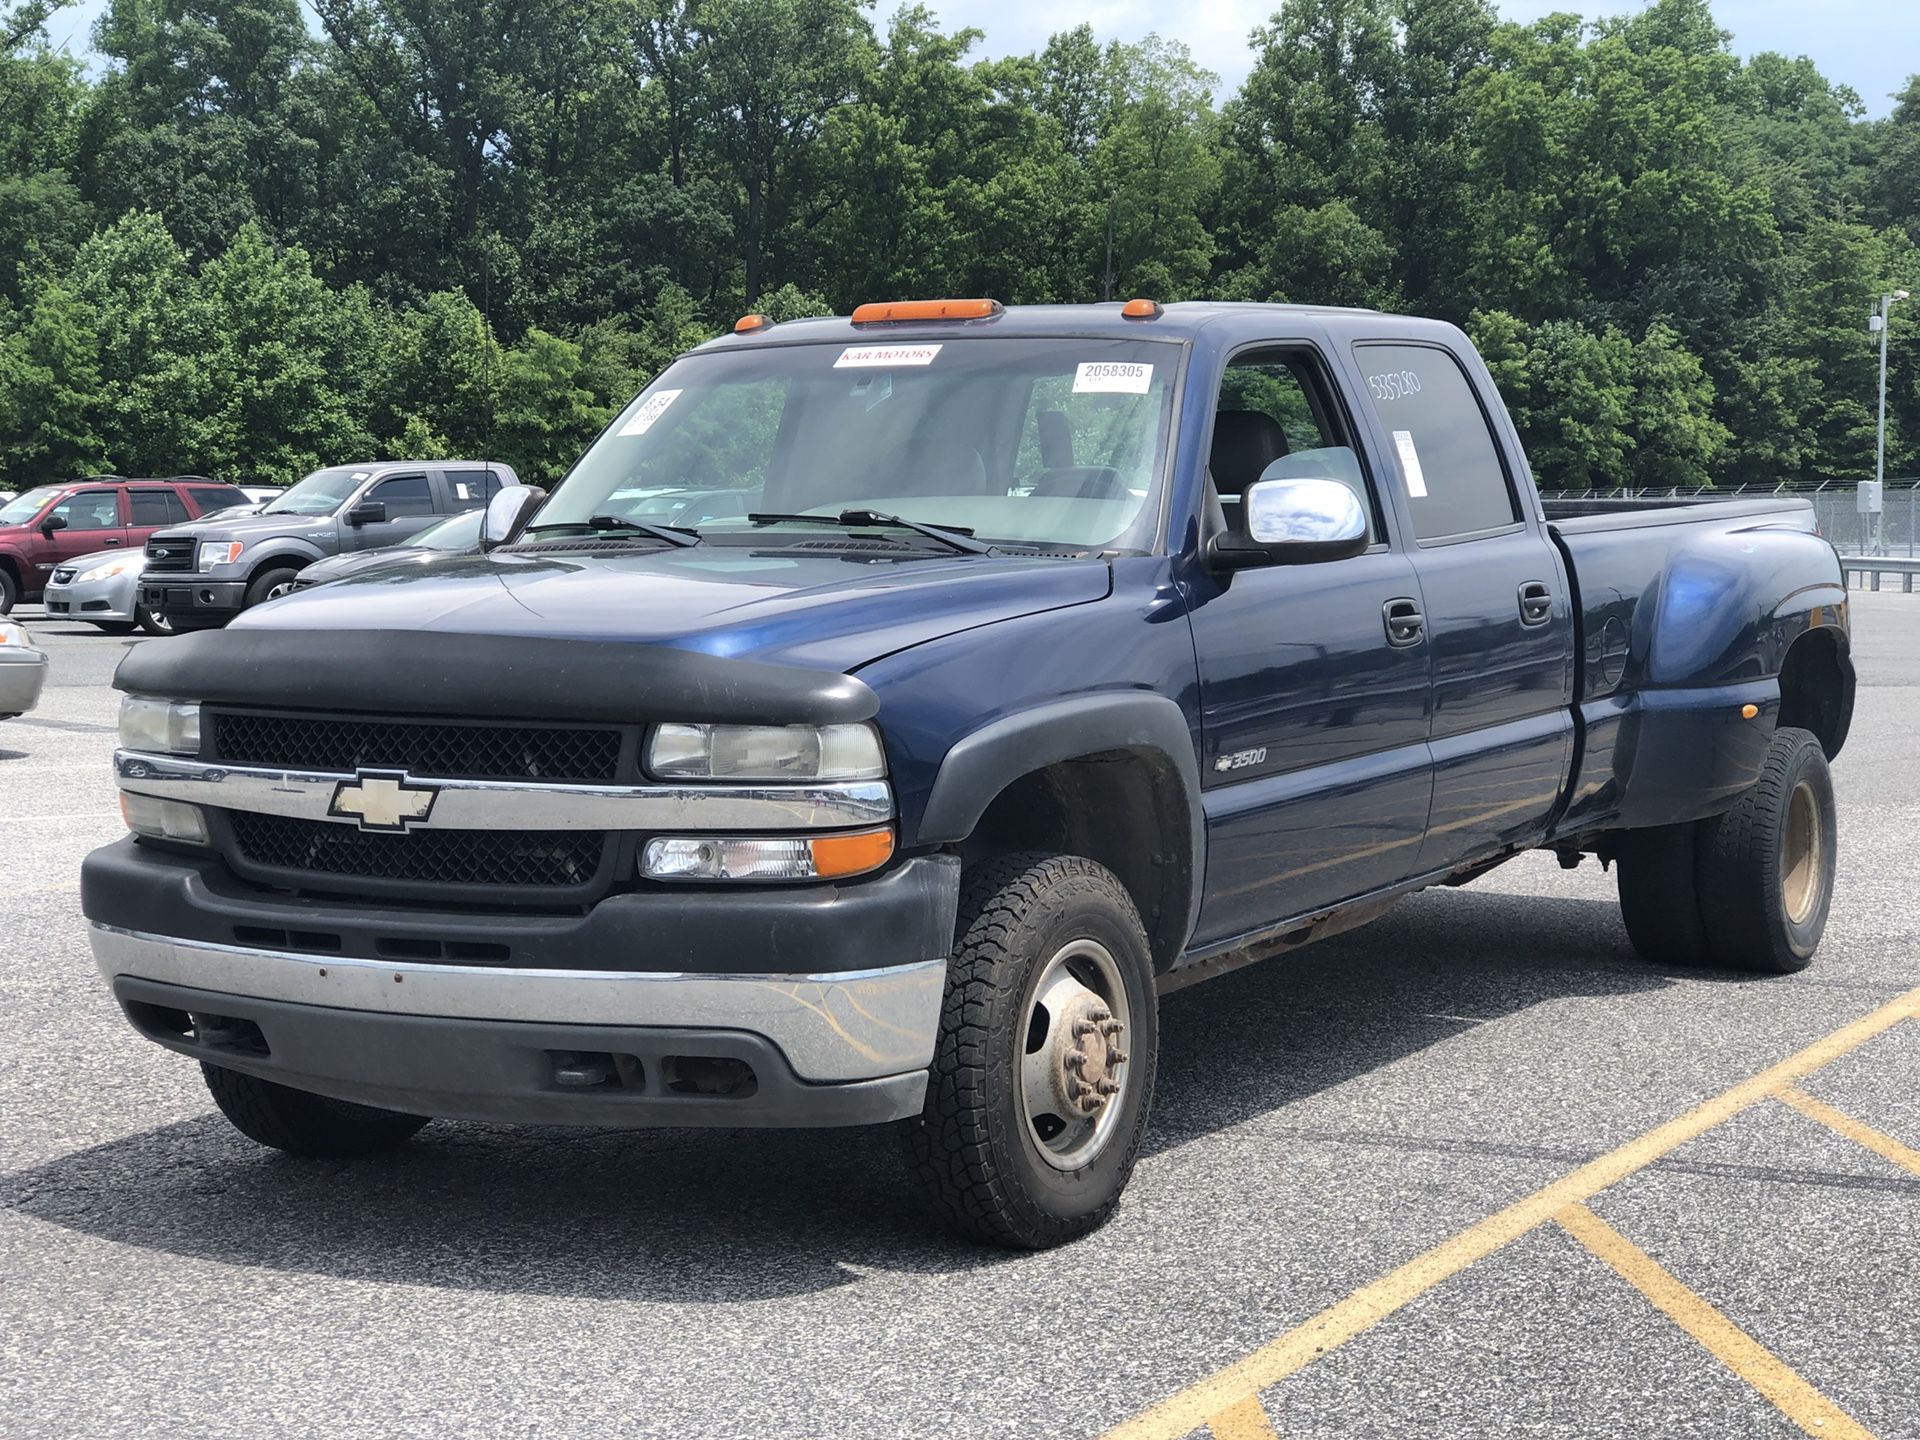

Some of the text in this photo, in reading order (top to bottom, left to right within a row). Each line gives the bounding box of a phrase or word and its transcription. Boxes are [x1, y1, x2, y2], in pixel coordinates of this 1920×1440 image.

[841, 349, 934, 361] KAR MOTORS
[1085, 364, 1144, 378] 2058305
[1231, 746, 1267, 769] 3500
